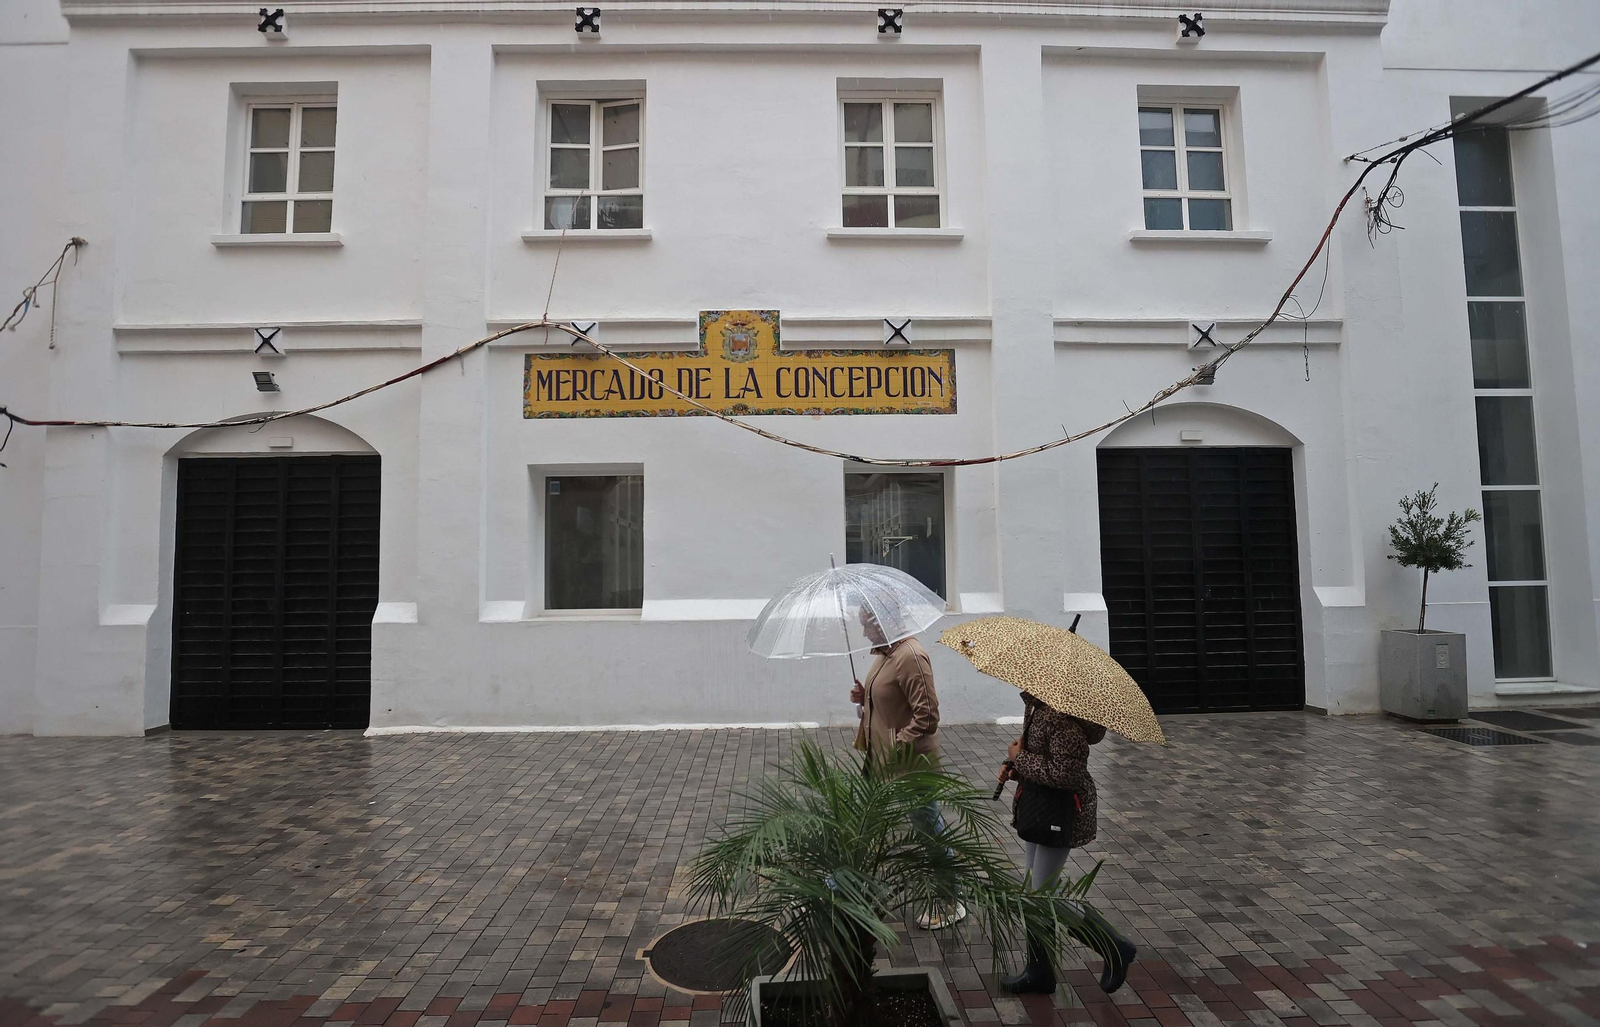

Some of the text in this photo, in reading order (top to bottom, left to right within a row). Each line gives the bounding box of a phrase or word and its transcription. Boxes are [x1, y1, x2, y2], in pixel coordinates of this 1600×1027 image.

[536, 366, 944, 401] MERCADO DE LA CONCEPCION
